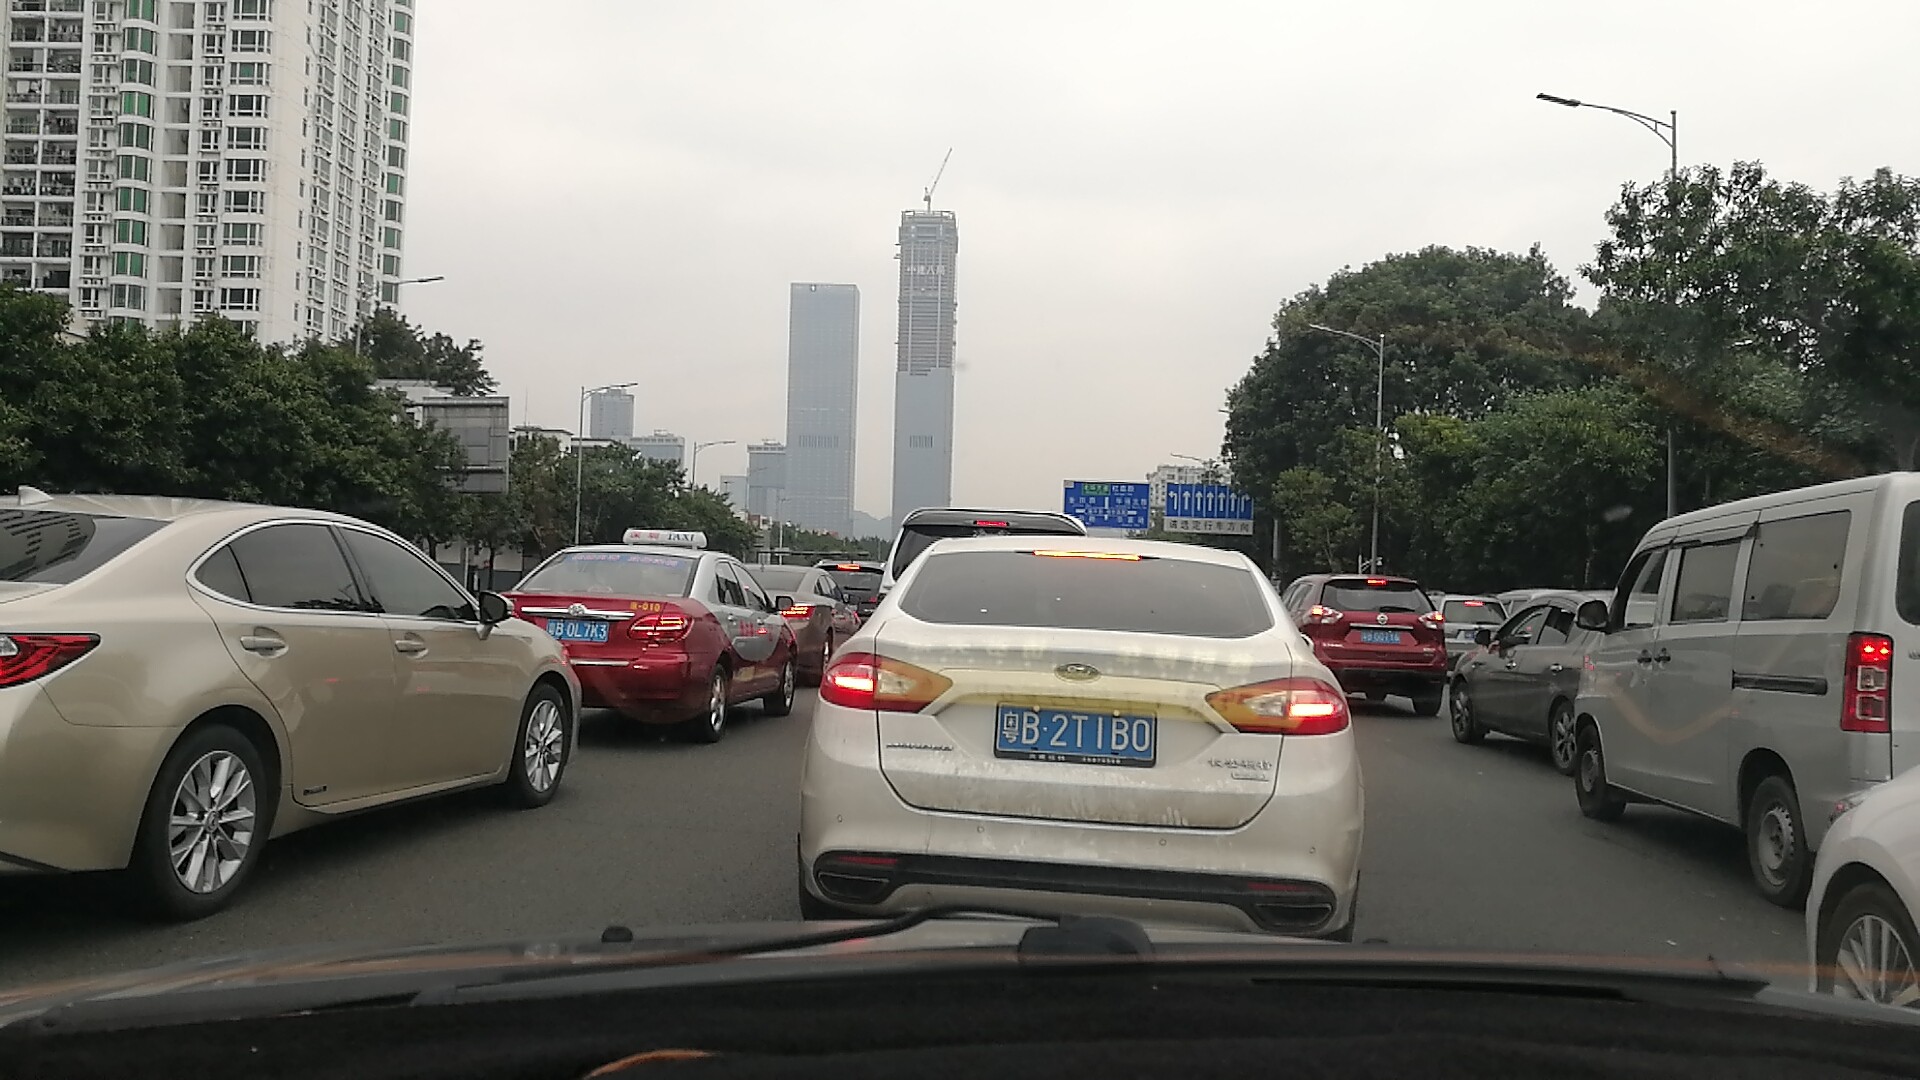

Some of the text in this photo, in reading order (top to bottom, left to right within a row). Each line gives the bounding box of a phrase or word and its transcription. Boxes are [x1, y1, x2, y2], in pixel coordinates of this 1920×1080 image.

[1169, 520, 1250, 533] 请选定行车方向
[668, 533, 695, 541] TAXI
